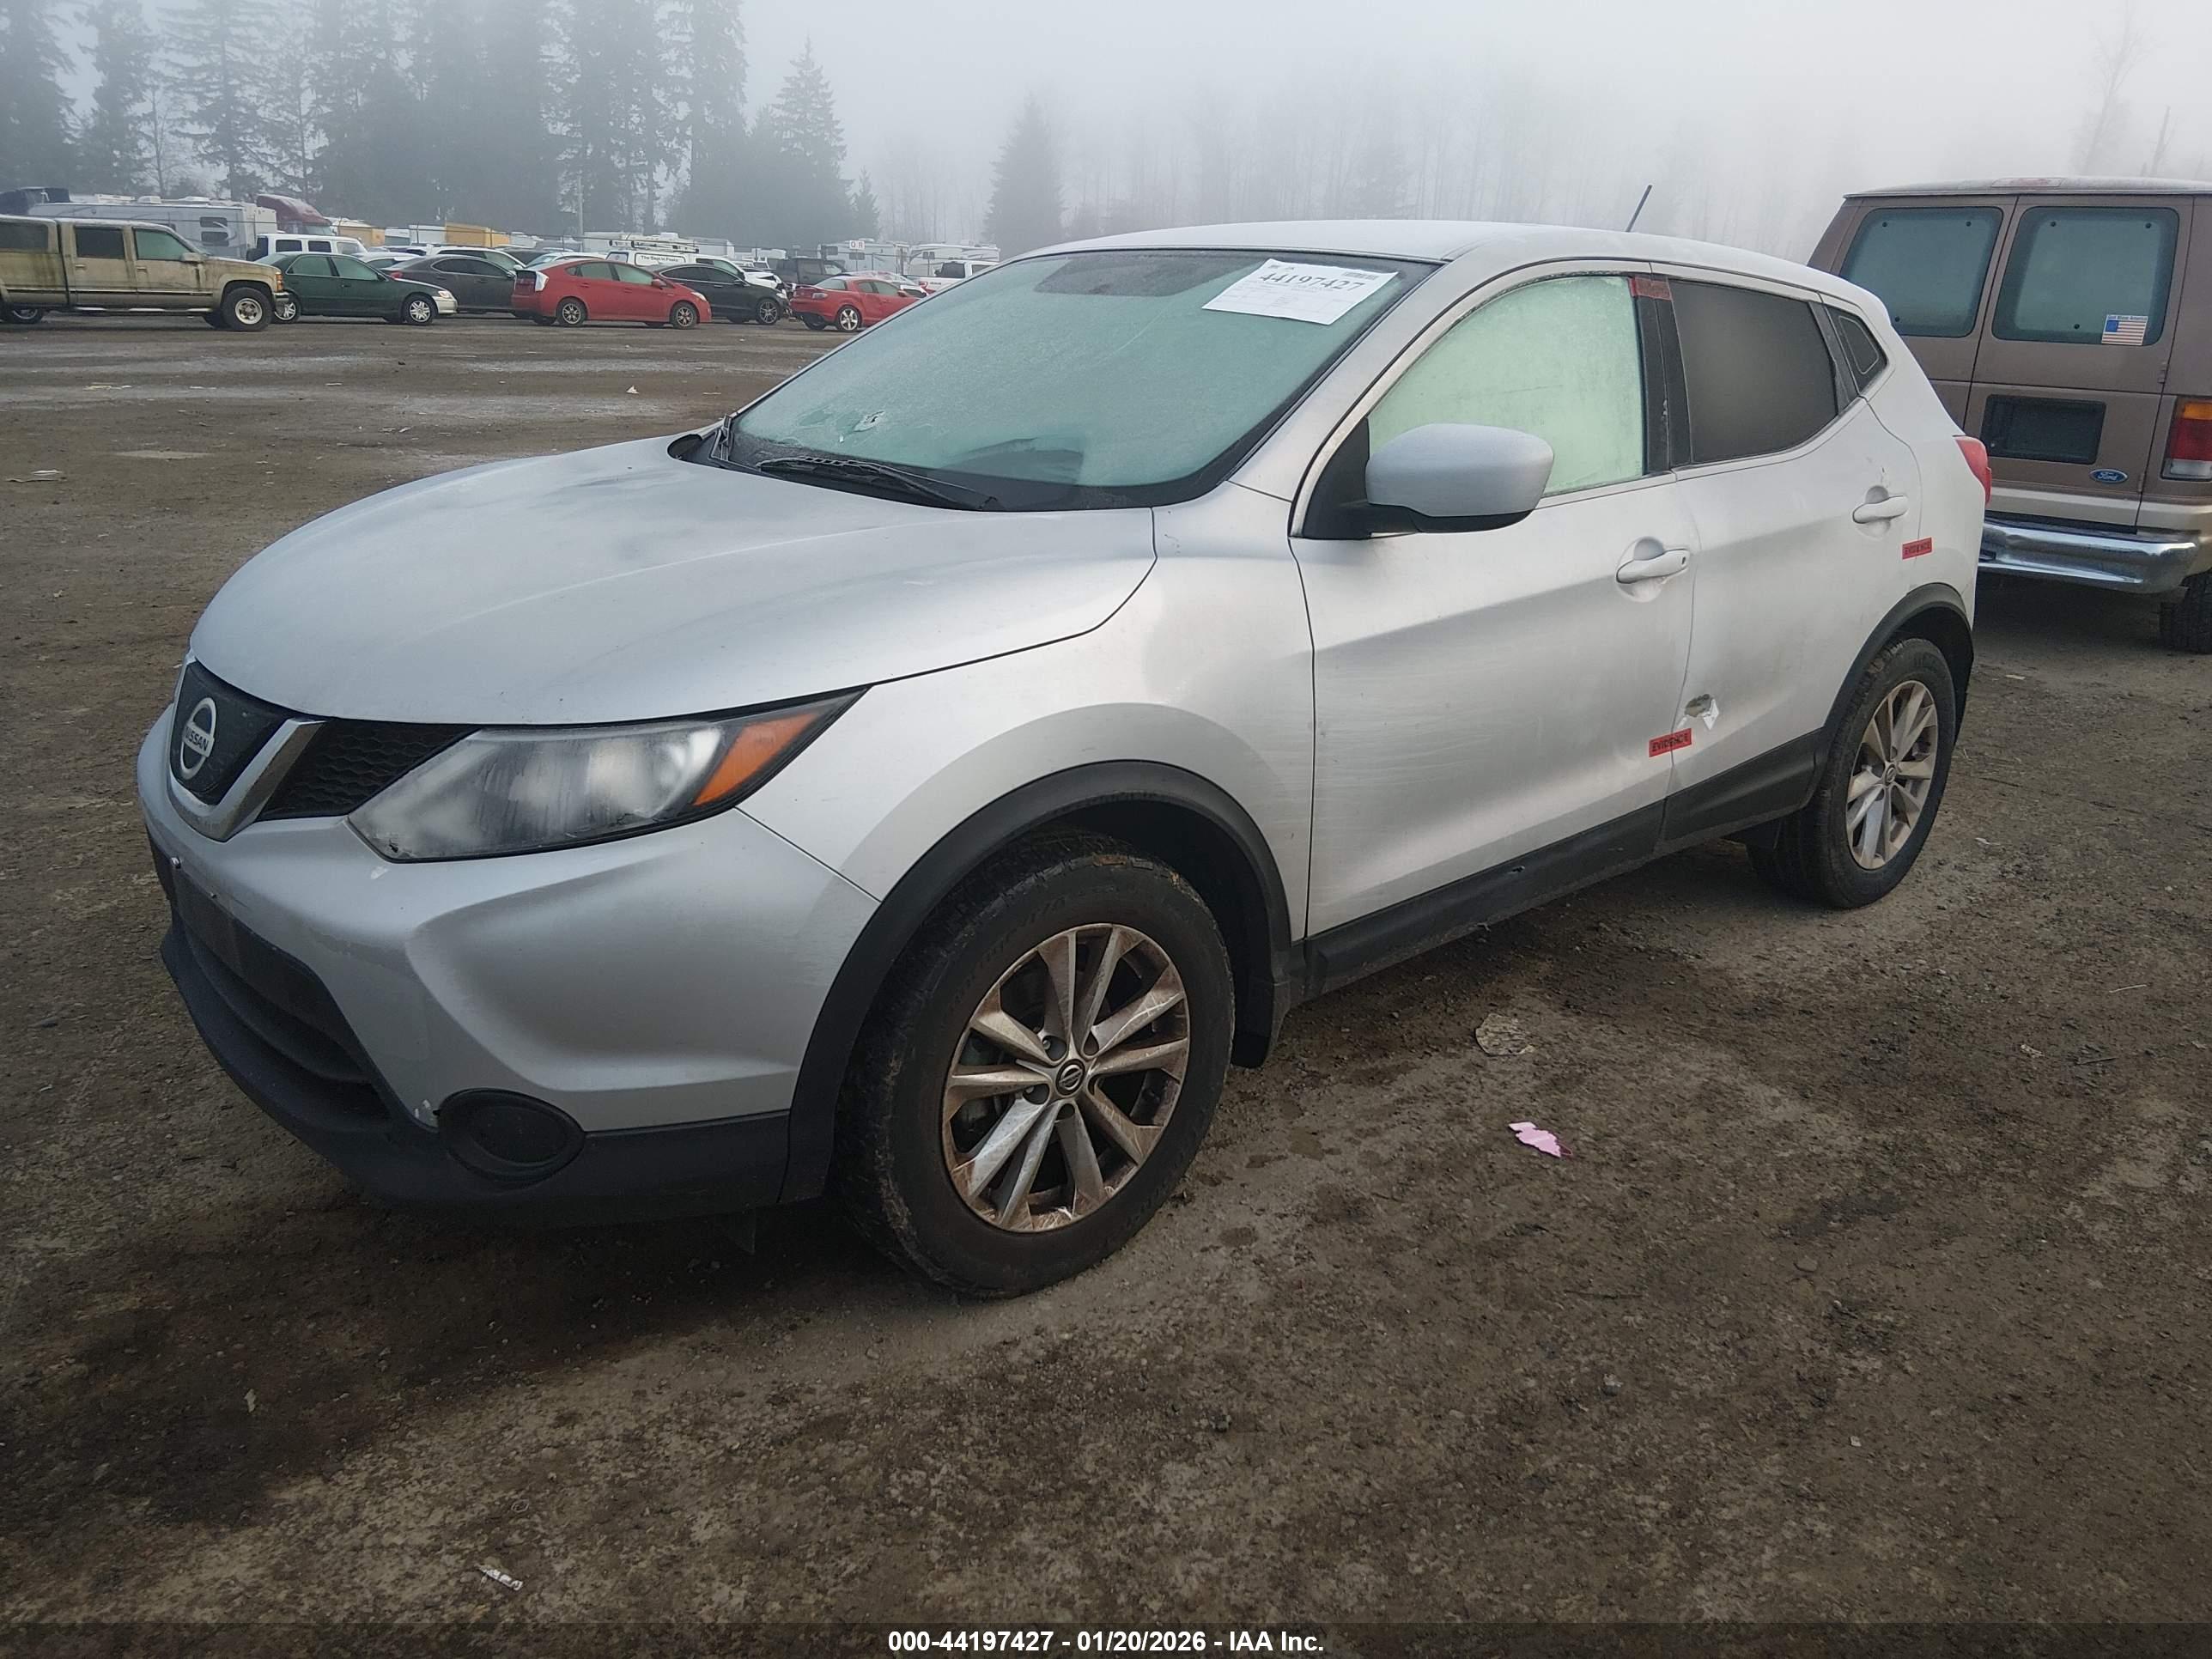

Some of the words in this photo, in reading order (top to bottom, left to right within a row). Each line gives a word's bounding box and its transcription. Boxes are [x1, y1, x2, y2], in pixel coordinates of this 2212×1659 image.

[1259, 272, 1365, 292] 44197427
[2097, 471, 2119, 481] Ford
[185, 726, 209, 752] NISSAN
